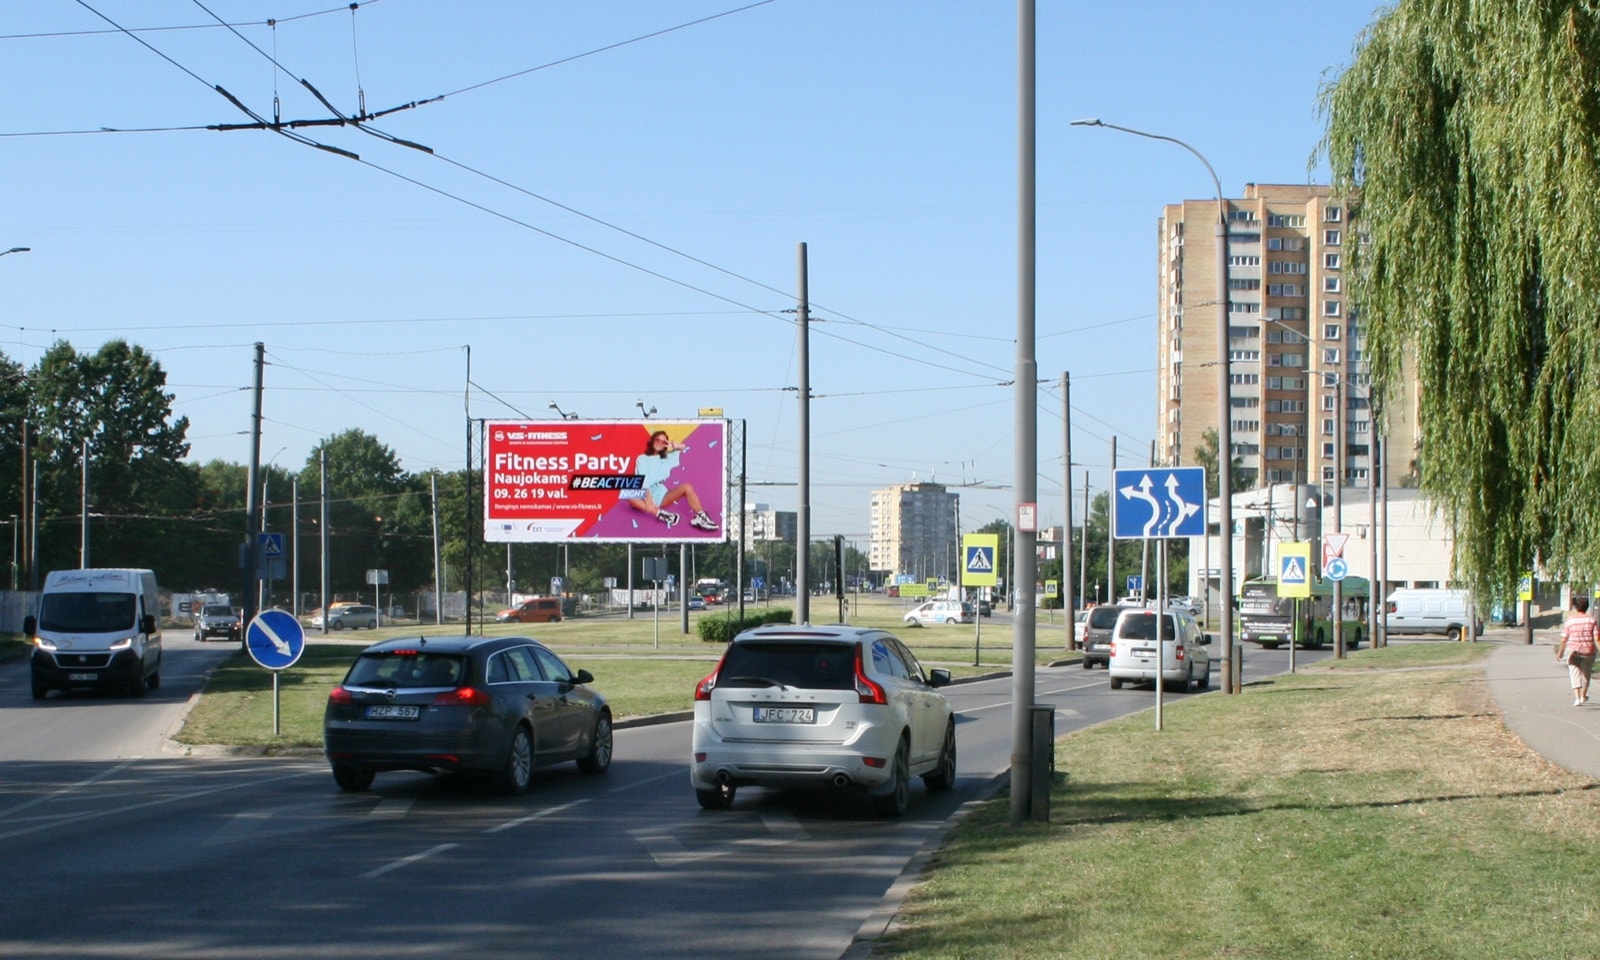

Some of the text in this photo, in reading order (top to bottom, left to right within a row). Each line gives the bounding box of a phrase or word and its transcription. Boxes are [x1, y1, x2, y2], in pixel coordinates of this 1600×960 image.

[495, 452, 631, 473] Fitness Party
[494, 473, 568, 487] Naujokams
[572, 476, 642, 488] #BEACTIVE
[494, 489, 568, 499] 09. 26 19 val.
[620, 490, 646, 498] NIGHT
[371, 706, 392, 715] HZP
[398, 706, 418, 716] 567
[760, 709, 812, 721] JFC 724
